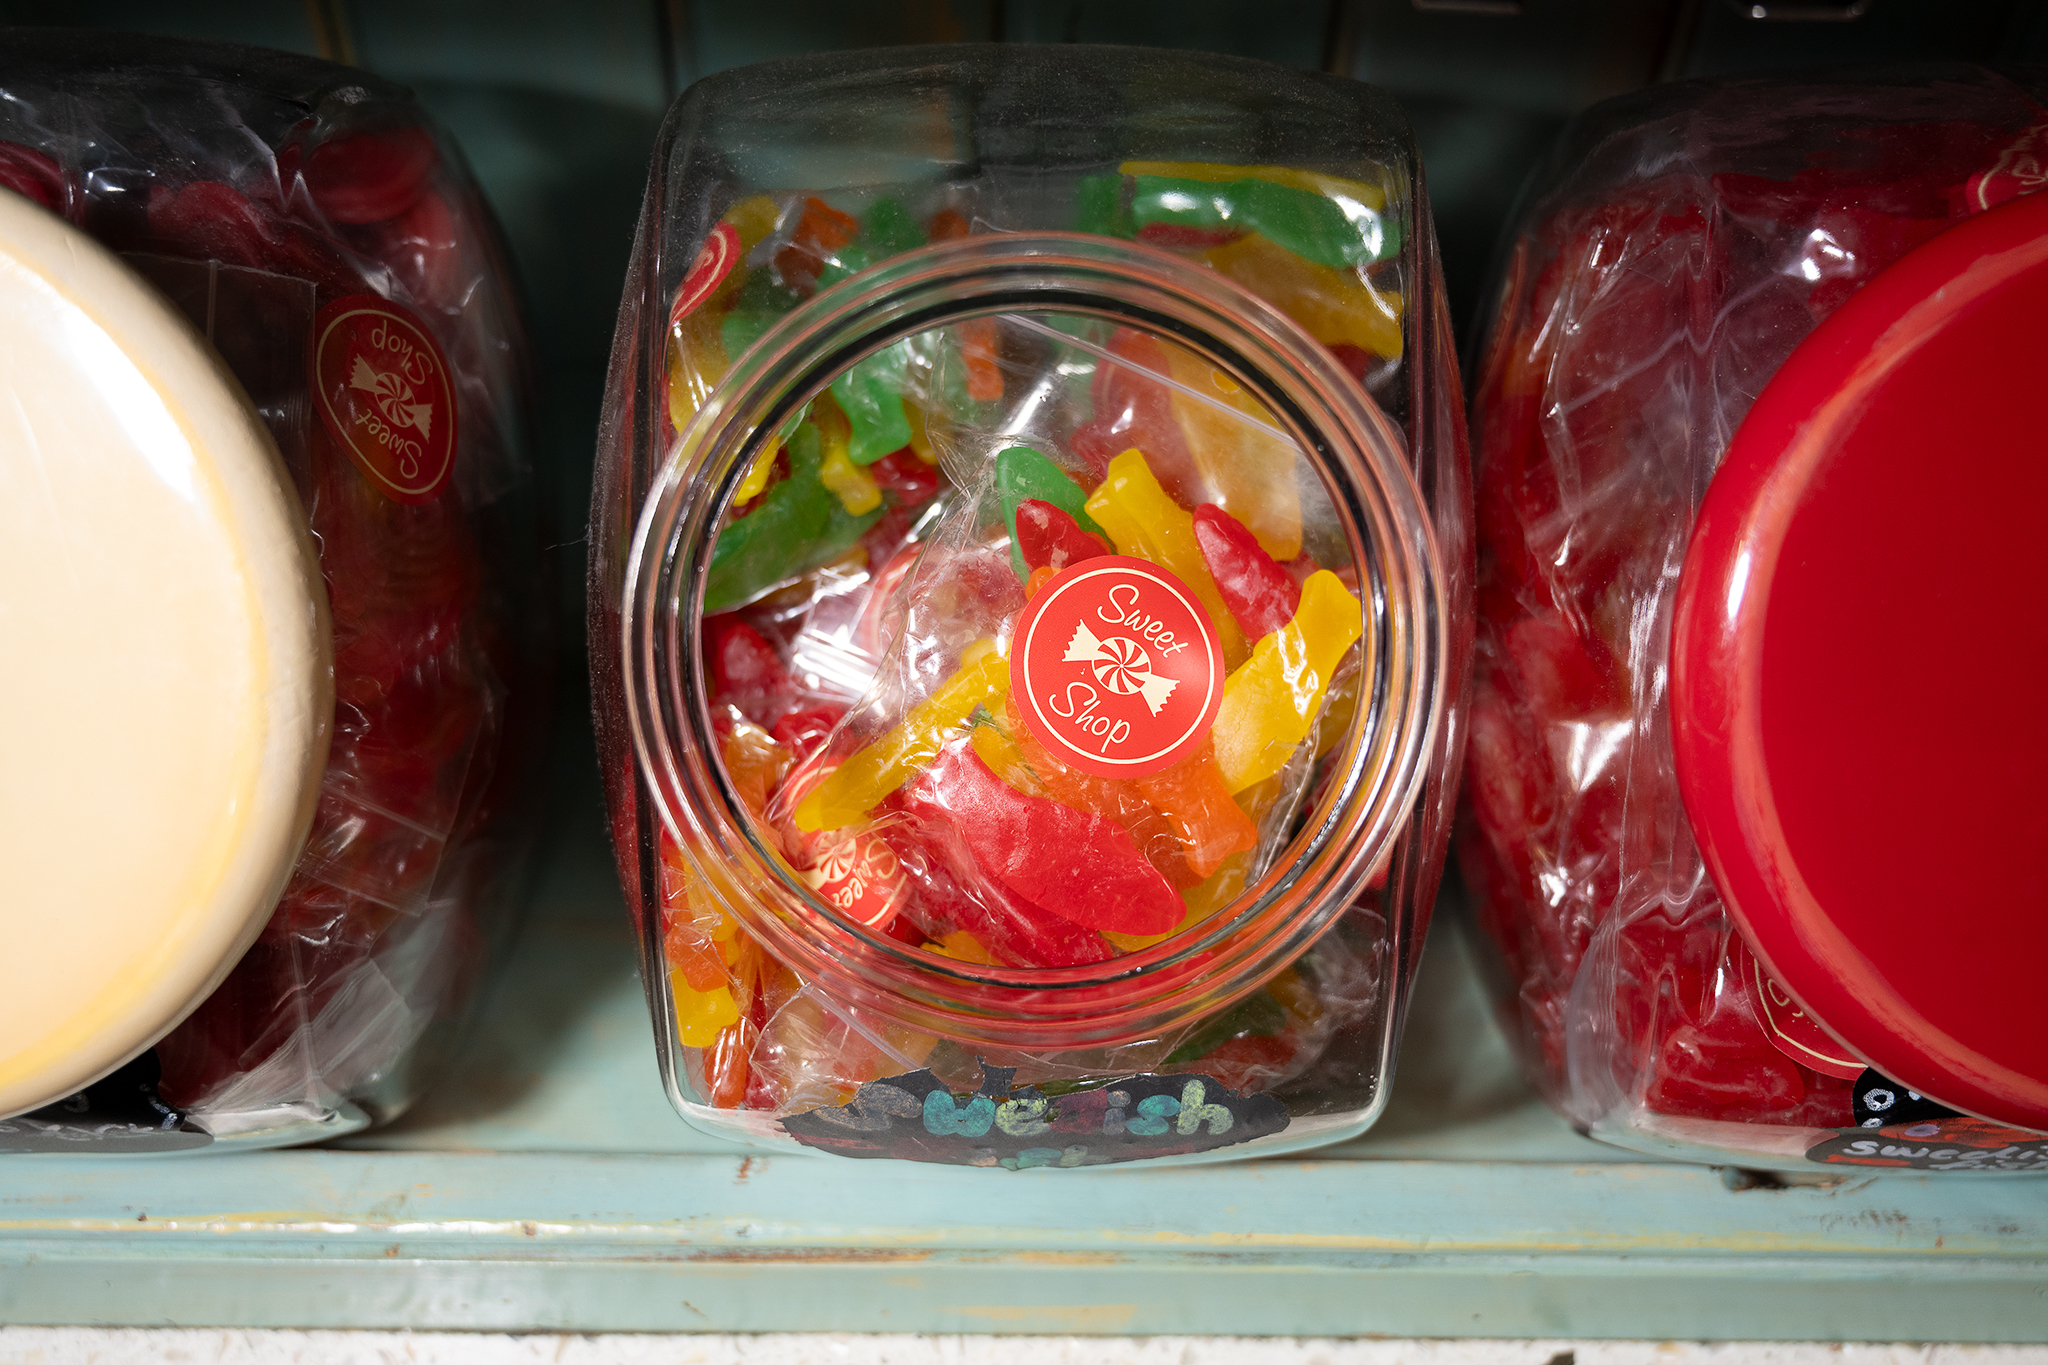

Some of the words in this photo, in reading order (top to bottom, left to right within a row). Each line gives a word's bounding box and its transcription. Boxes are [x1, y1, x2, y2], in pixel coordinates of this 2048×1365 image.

[371, 319, 434, 385] Shop
[356, 408, 422, 479] Sweet
[1097, 583, 1189, 658] Sweet
[1048, 681, 1131, 754] Shop
